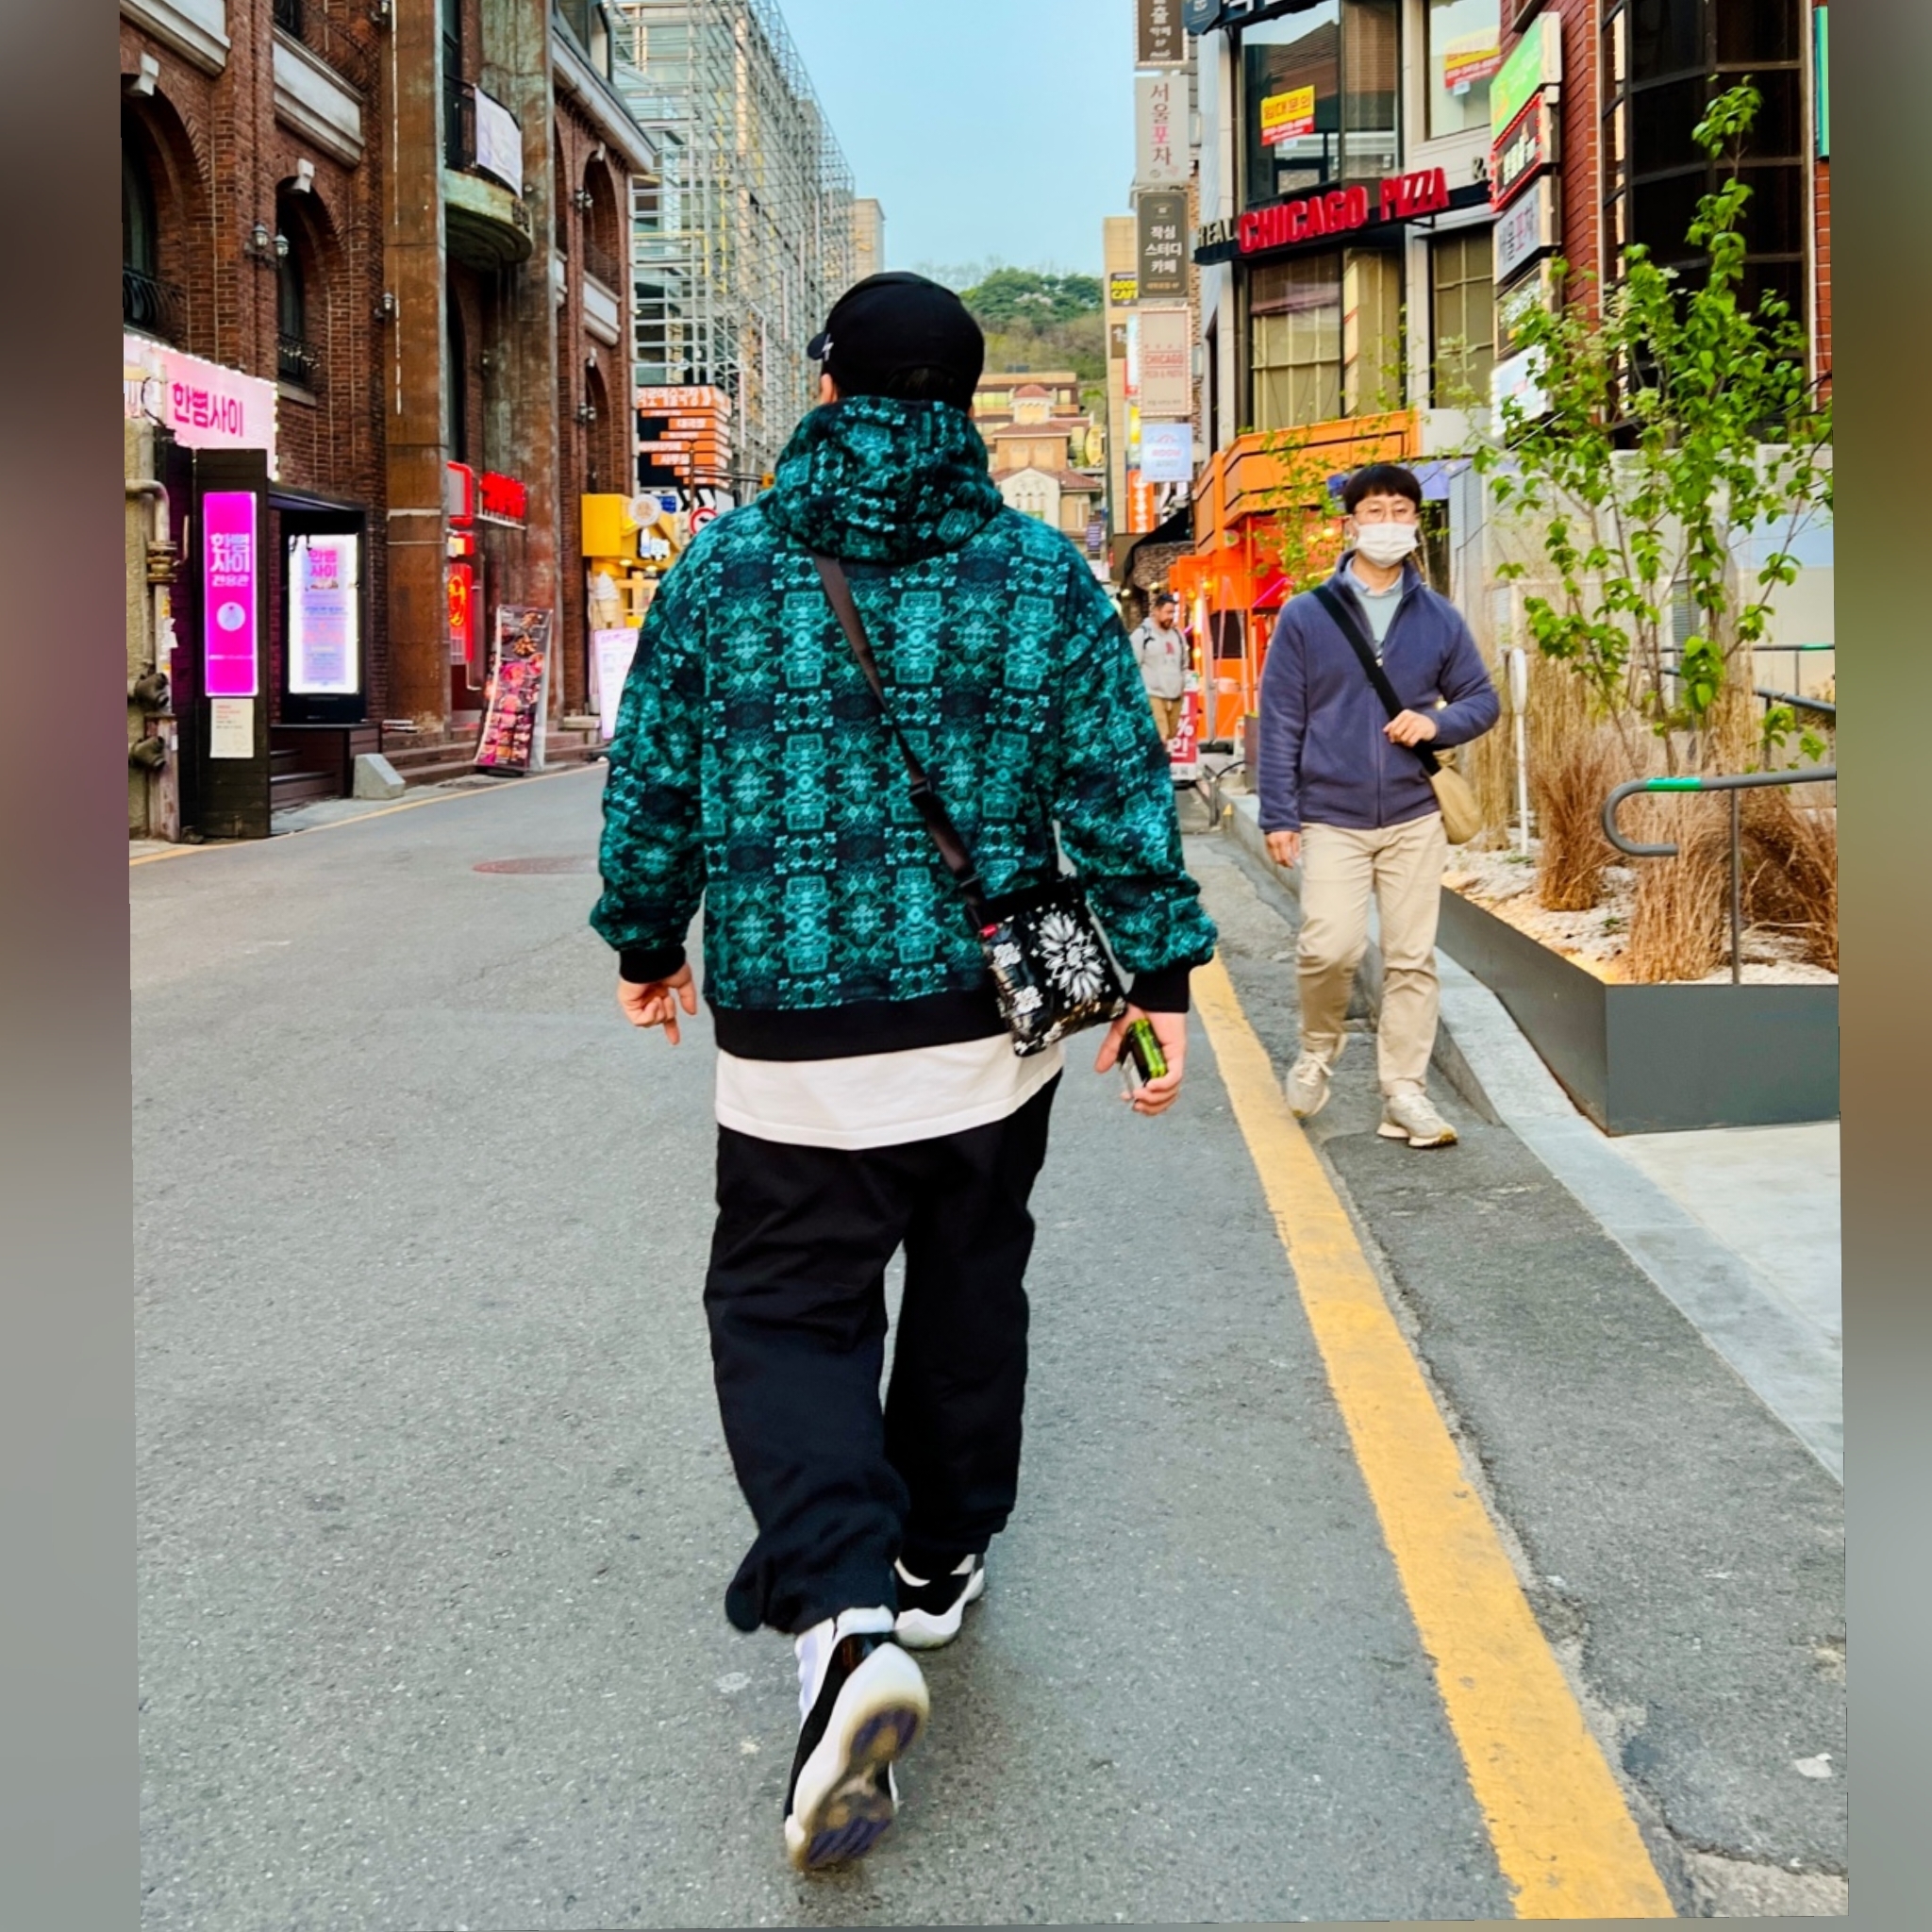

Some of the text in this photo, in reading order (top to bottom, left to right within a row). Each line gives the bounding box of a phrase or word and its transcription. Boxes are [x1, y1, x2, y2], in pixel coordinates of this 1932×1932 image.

[1150, 82, 1172, 166] 서울포차
[1197, 217, 1237, 247] REAL
[1238, 185, 1368, 254] CHICAGO
[1378, 166, 1451, 222] PIZZA
[1150, 225, 1176, 240] 작심
[1144, 242, 1182, 257] 스터디
[1151, 259, 1177, 274] 카페
[173, 382, 243, 438] 한뼘사이
[209, 553, 250, 573] 사이
